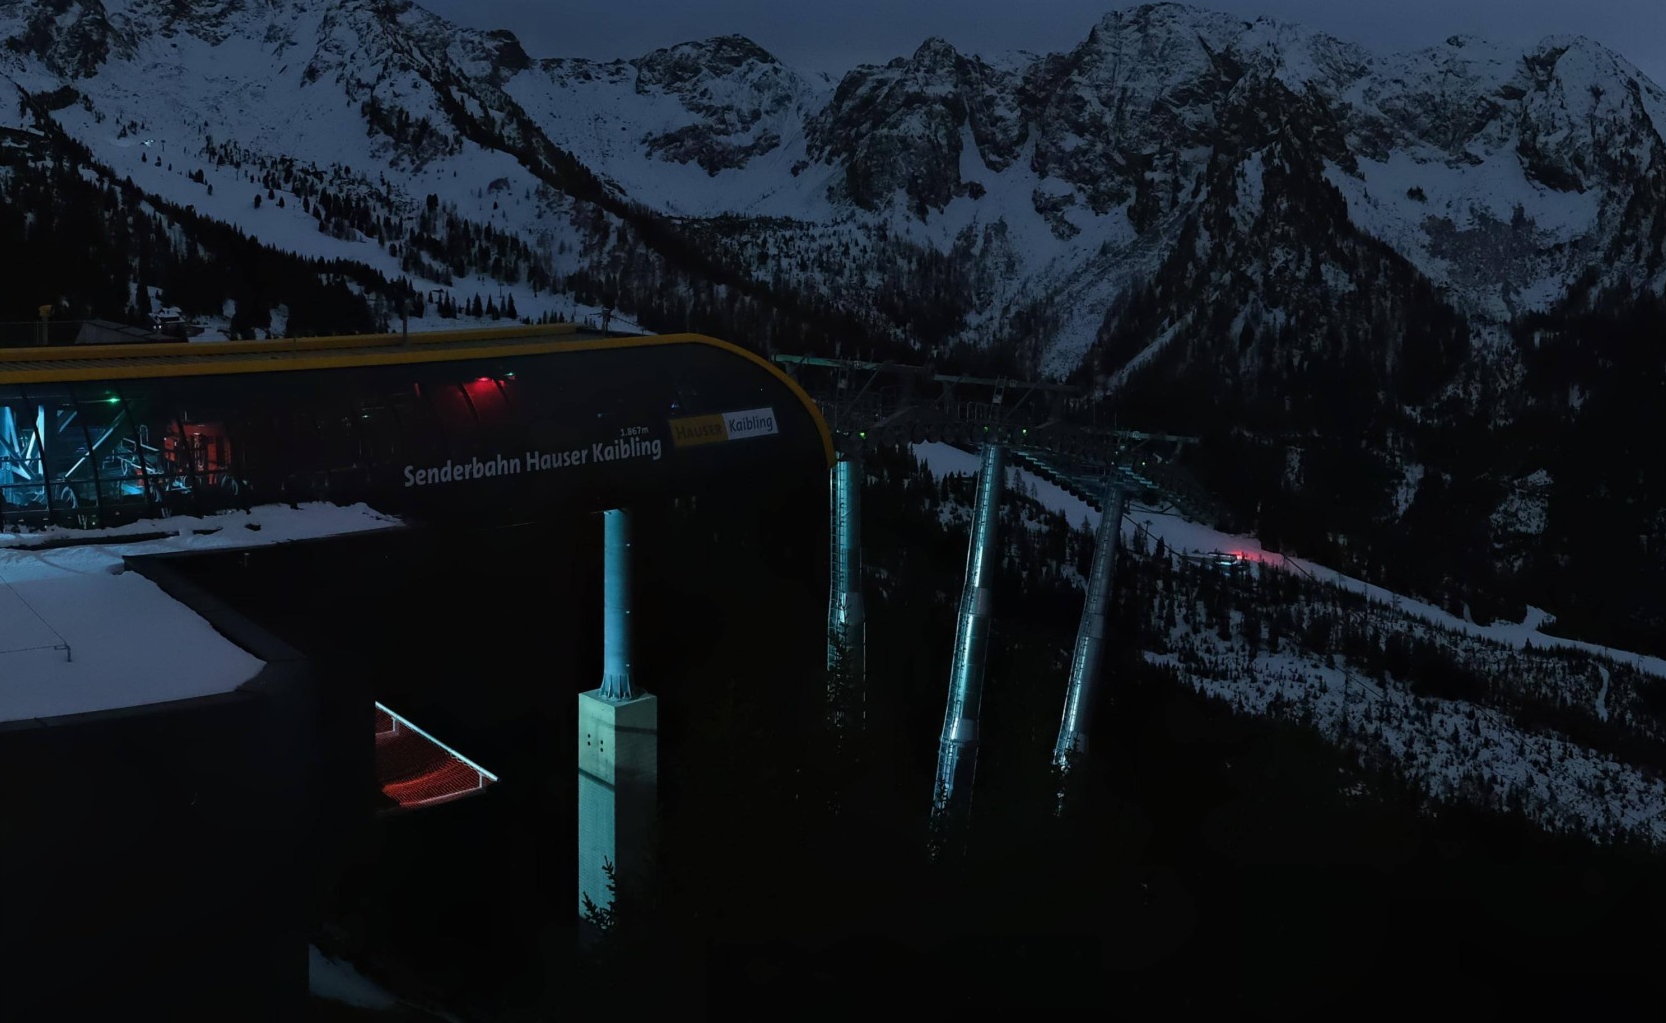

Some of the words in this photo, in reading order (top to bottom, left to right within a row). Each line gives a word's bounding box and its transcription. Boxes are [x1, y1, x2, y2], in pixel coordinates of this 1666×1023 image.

[620, 426, 649, 437] 1.867m
[675, 424, 723, 440] HAUSER
[728, 416, 773, 432] Kaibling
[403, 454, 521, 488] Senderbahn
[526, 448, 588, 472] Hauser
[592, 437, 662, 463] Kaibling
